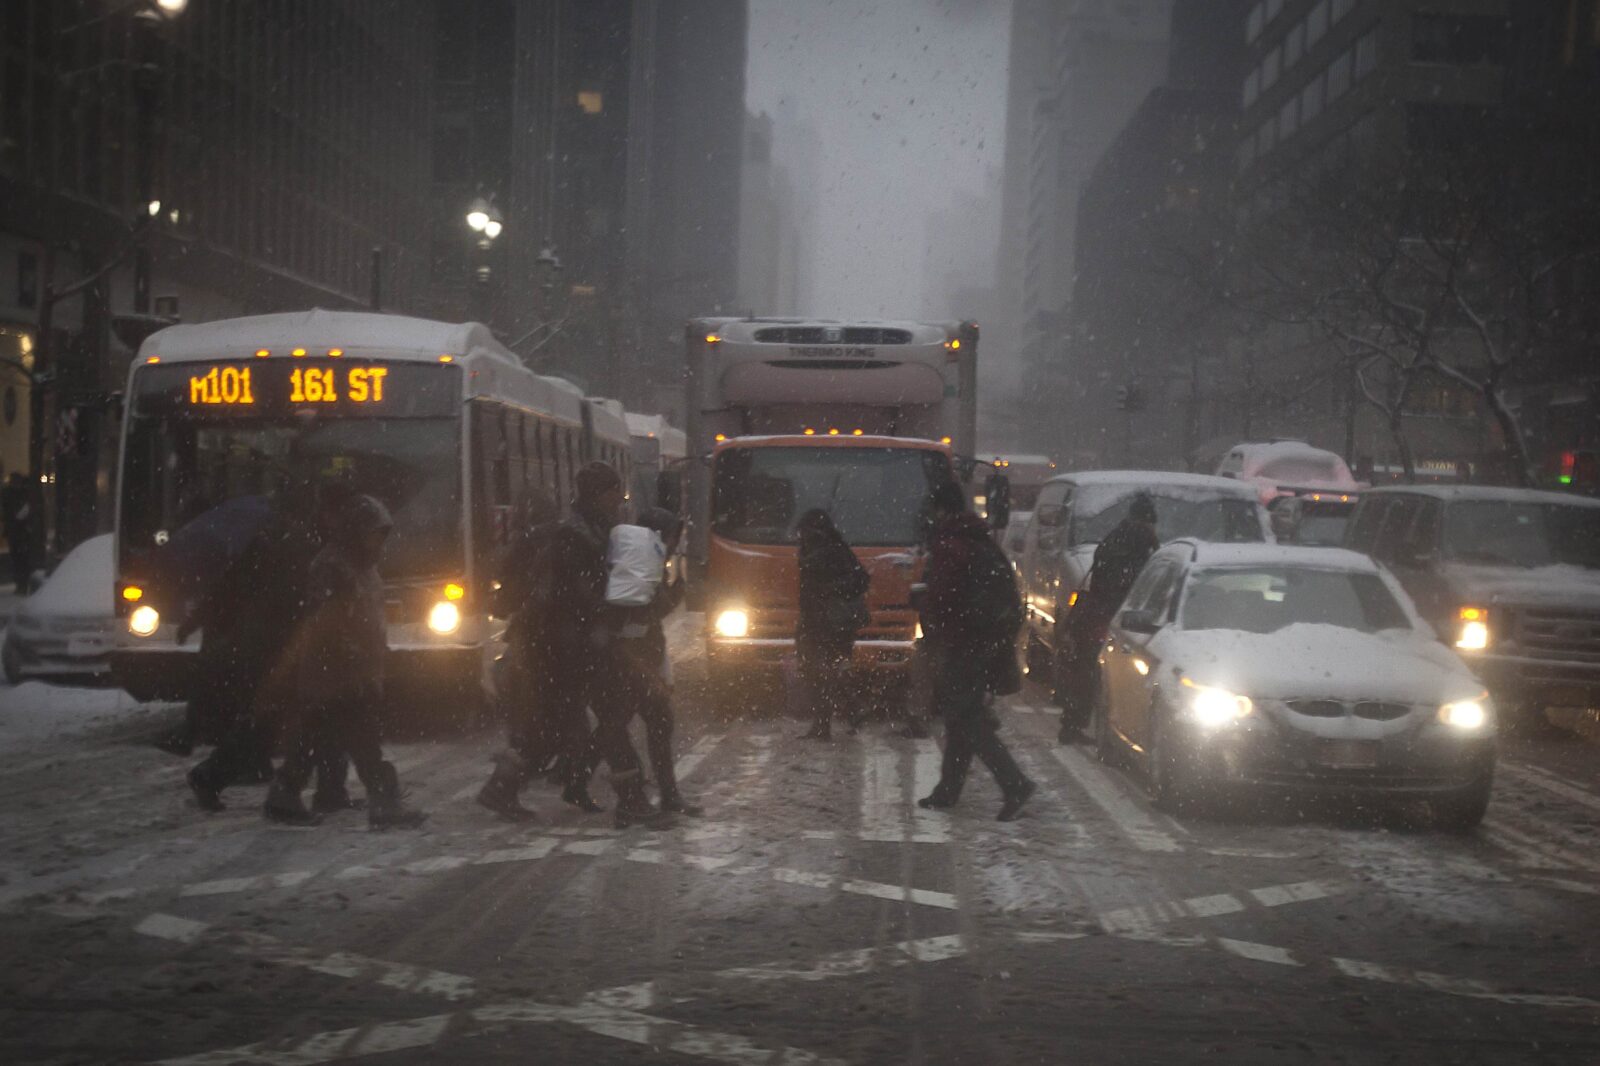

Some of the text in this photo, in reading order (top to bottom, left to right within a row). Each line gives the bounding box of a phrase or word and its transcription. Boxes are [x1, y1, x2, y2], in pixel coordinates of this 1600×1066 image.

[189, 366, 388, 404] M101 161 ST
